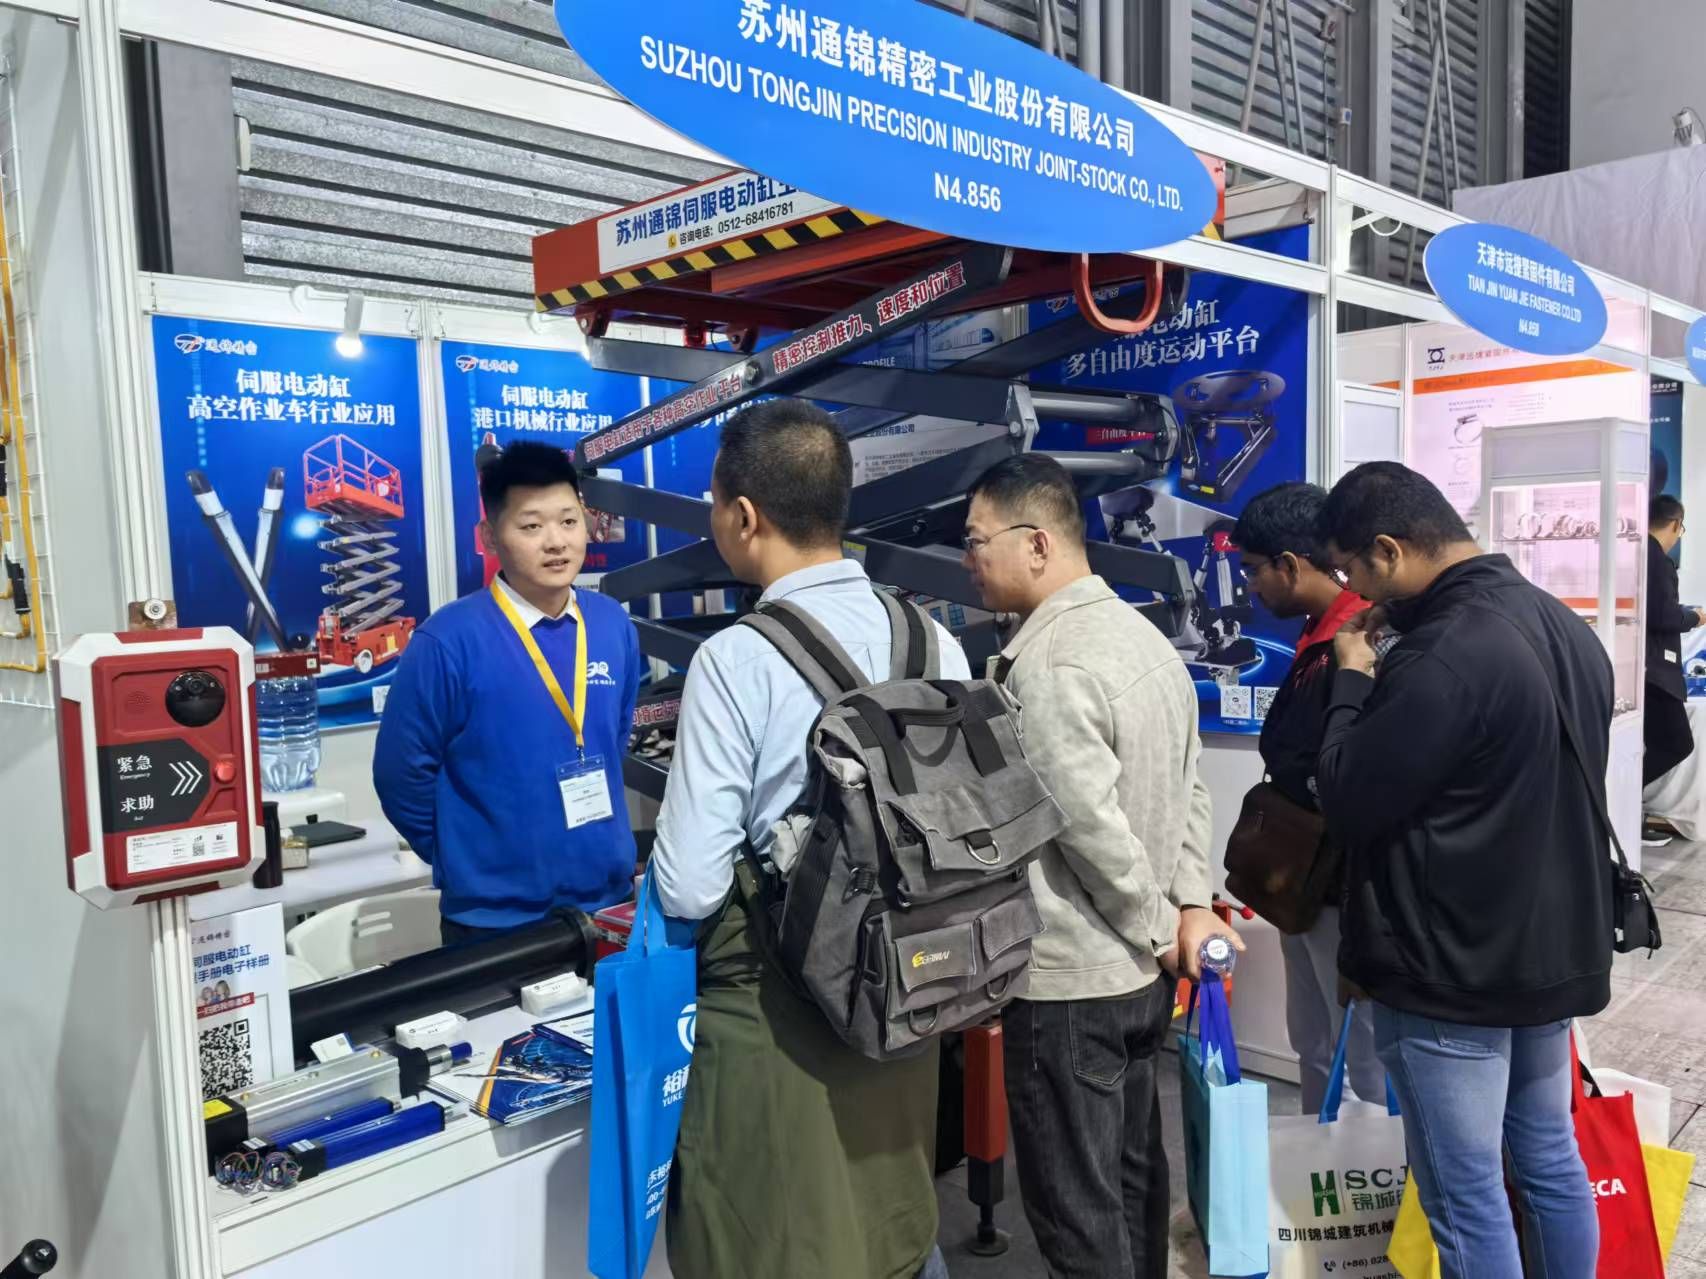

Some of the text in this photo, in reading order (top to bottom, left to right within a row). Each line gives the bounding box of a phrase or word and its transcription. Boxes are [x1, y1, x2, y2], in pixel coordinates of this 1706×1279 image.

[738, 0, 1135, 157] 苏州通锦精密工业股份有限公司
[640, 36, 1184, 211] SUZHOU TONGJIN PRECISION INDUSTRY JOINT-STOCK CO., LTD.
[934, 172, 1001, 212] N4.856
[718, 201, 794, 234] 0512-68416781
[1467, 274, 1485, 294] TIAN
[1487, 280, 1498, 297] JIN
[772, 261, 966, 374] 精密控制推力、速度和位置
[1066, 325, 1260, 379] 多自由度运动平台
[236, 368, 352, 398] 伺服电动缸
[502, 385, 588, 409] 伺服电动缸
[186, 394, 396, 426] 高空作业车行业应用
[474, 407, 612, 433] 港口机械行业应用
[117, 755, 152, 773] 紧急
[120, 795, 154, 813] 求助
[195, 954, 269, 983] 手册电子样册
